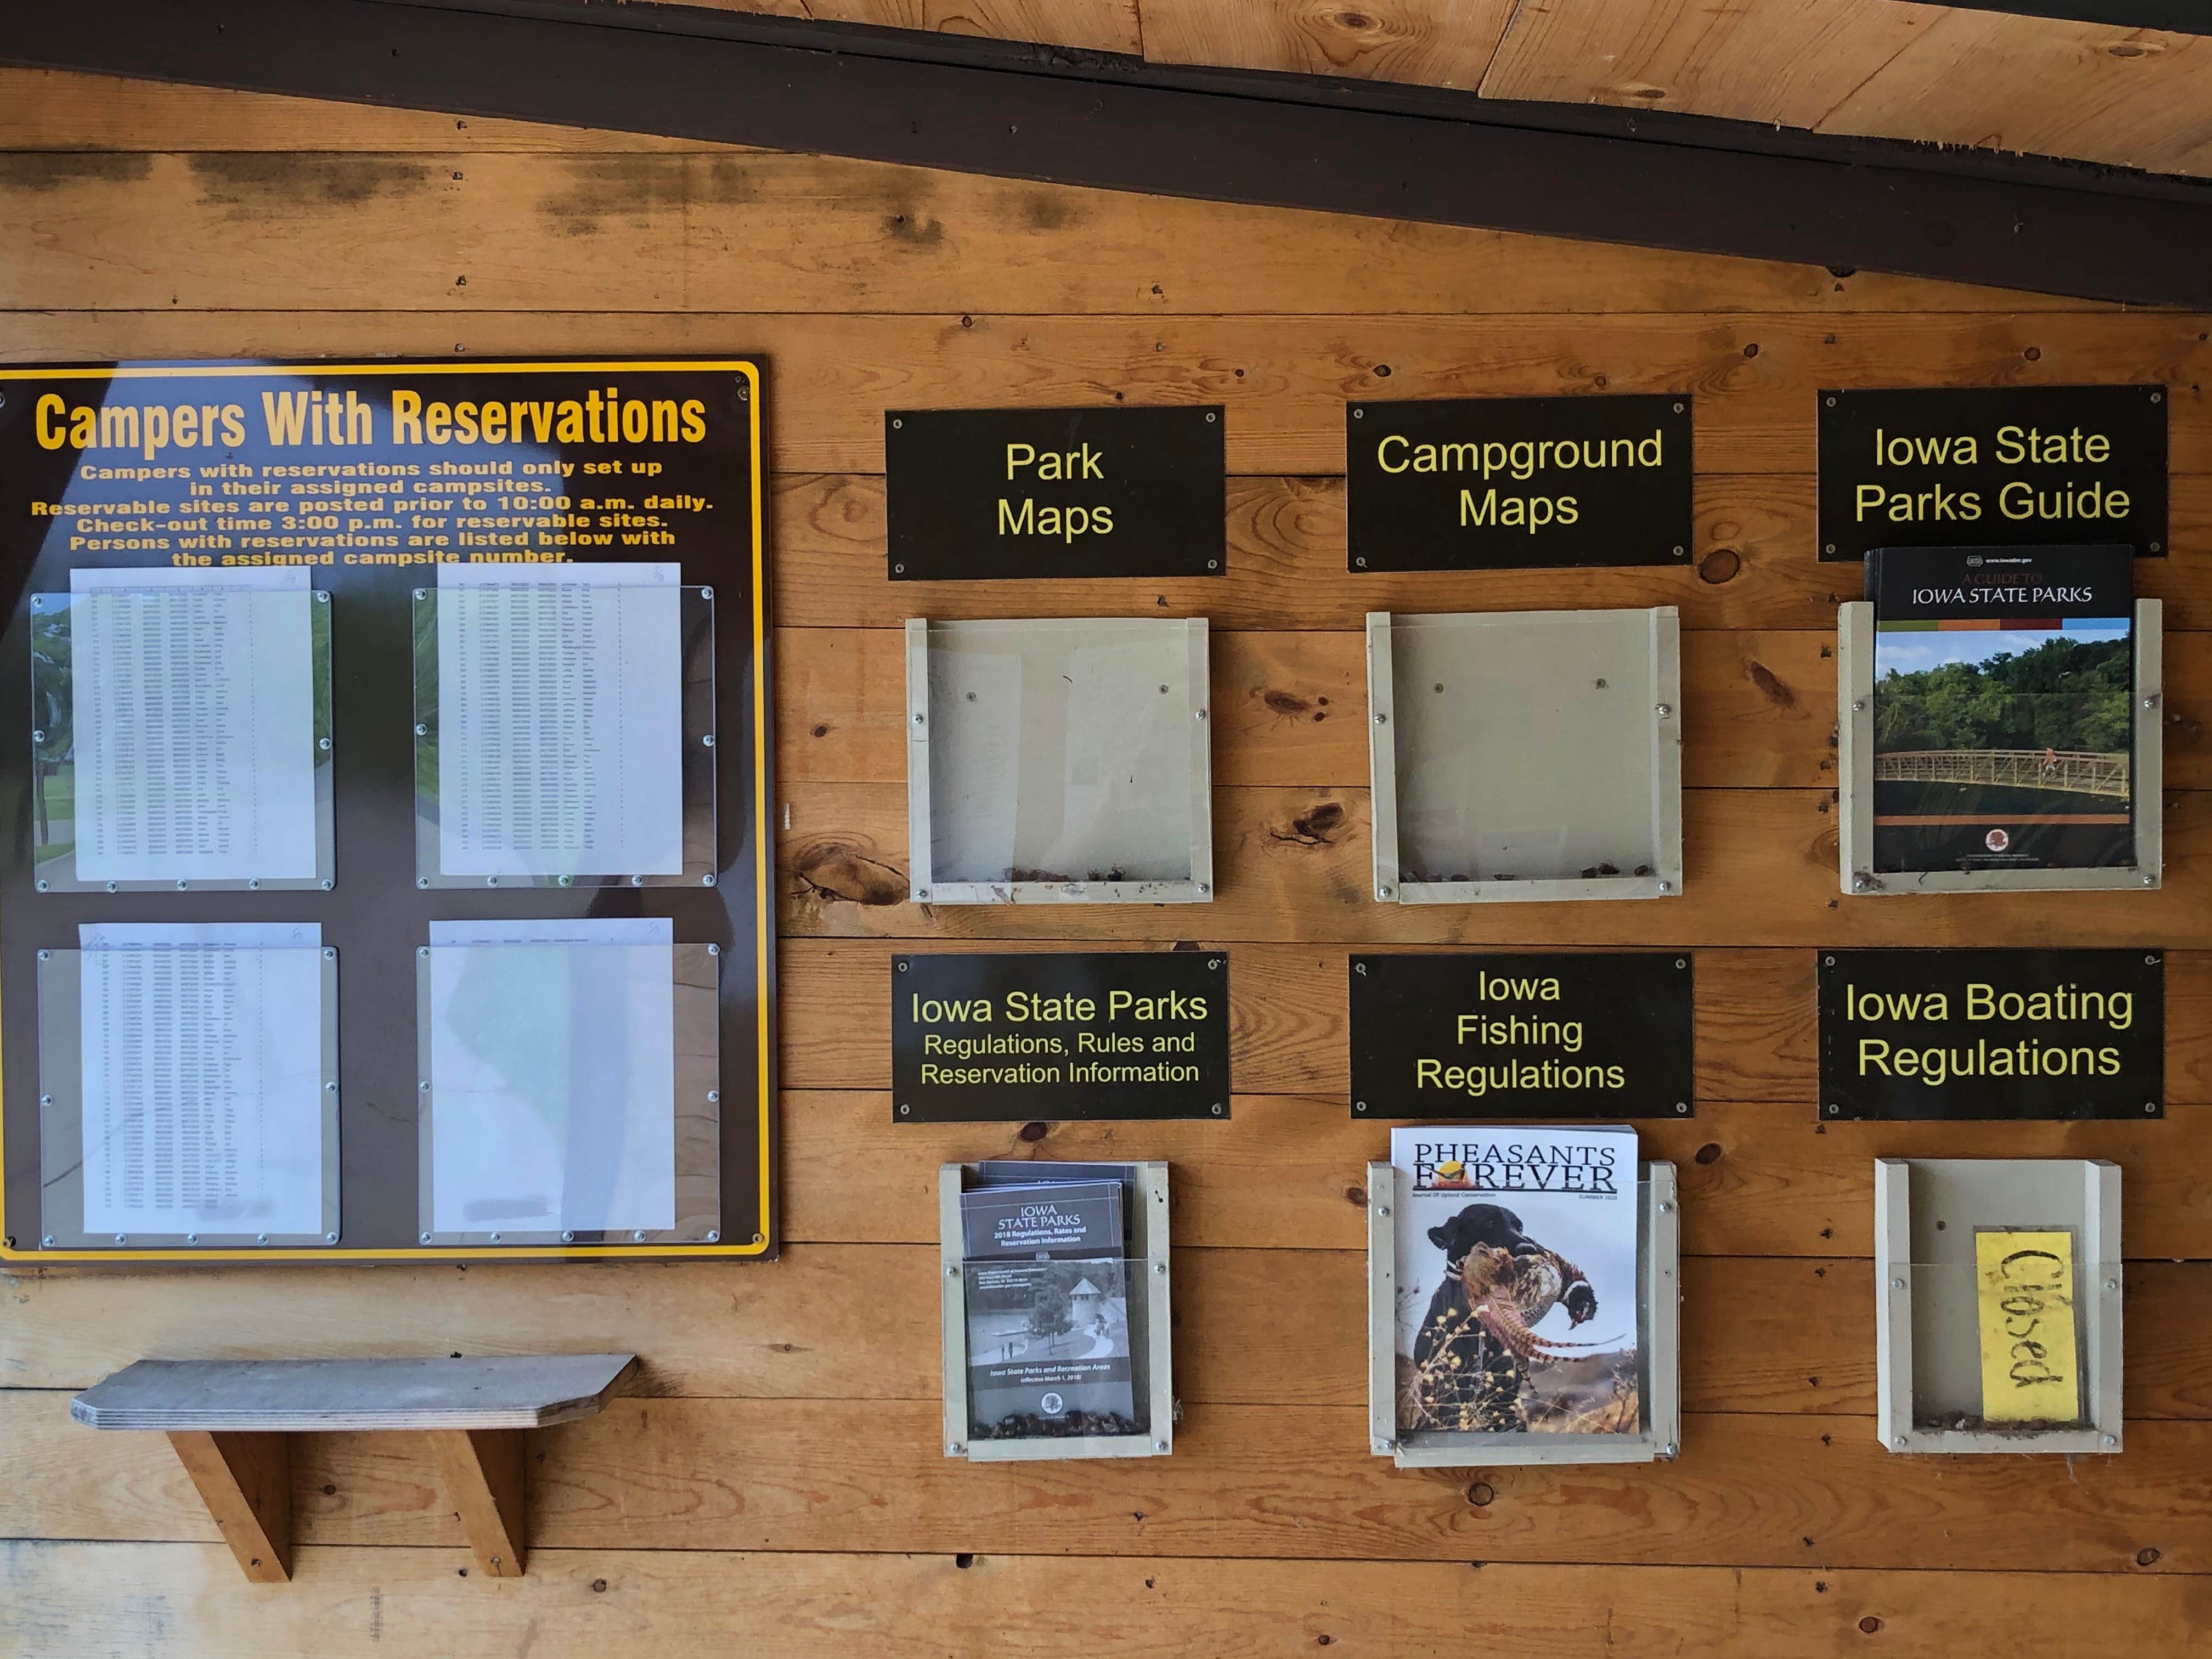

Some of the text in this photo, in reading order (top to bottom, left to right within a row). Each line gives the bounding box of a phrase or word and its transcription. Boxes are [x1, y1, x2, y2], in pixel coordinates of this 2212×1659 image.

[37, 387, 706, 460] Campers With Reservations
[1378, 430, 1662, 479] Campground
[1877, 426, 2109, 466] Iowa State
[81, 460, 662, 481] Campers with reservations should only set up
[1008, 443, 1103, 479] Park
[190, 479, 550, 496] in their assigned campsites.
[32, 495, 713, 515] Reservable sites are posted prior to 10:00 a.m. daily.
[1461, 489, 1578, 534] Maps
[1857, 482, 2129, 522] Parks Guide
[77, 513, 668, 532] Check-out time 3:00 p.m. for reservable sites.
[999, 499, 1113, 543] Maps
[70, 531, 675, 550] Persons with reservations are listed below with
[172, 549, 573, 566] the assigned campsite number.
[1962, 573, 2042, 584] A GUIDE TO
[1913, 586, 2092, 605] IOWA STATE PARKS
[1480, 971, 1560, 1001] Iowa
[913, 990, 1207, 1023] Iowa State Parks
[1848, 984, 2132, 1030] Iowa Boating
[926, 1032, 1194, 1059] Regulations, Rules and
[1458, 1015, 1582, 1052] Fishing
[922, 1062, 1198, 1084] Reservation Information
[1860, 1039, 2120, 1086] Regulations
[1418, 1059, 1625, 1096] Regulations
[1414, 1144, 1615, 1166] PHEASANTS
[998, 1214, 1081, 1230] STATE PARKS
[1020, 1204, 1058, 1217] IOWA
[994, 1231, 1011, 1239] 2018
[1012, 1228, 1053, 1239] Regulations,
[1073, 1226, 1087, 1234] and
[1001, 1235, 1081, 1247] Reservation Information
[2000, 1249, 2064, 1389] Closed
[1057, 1364, 1091, 1372] Recreation
